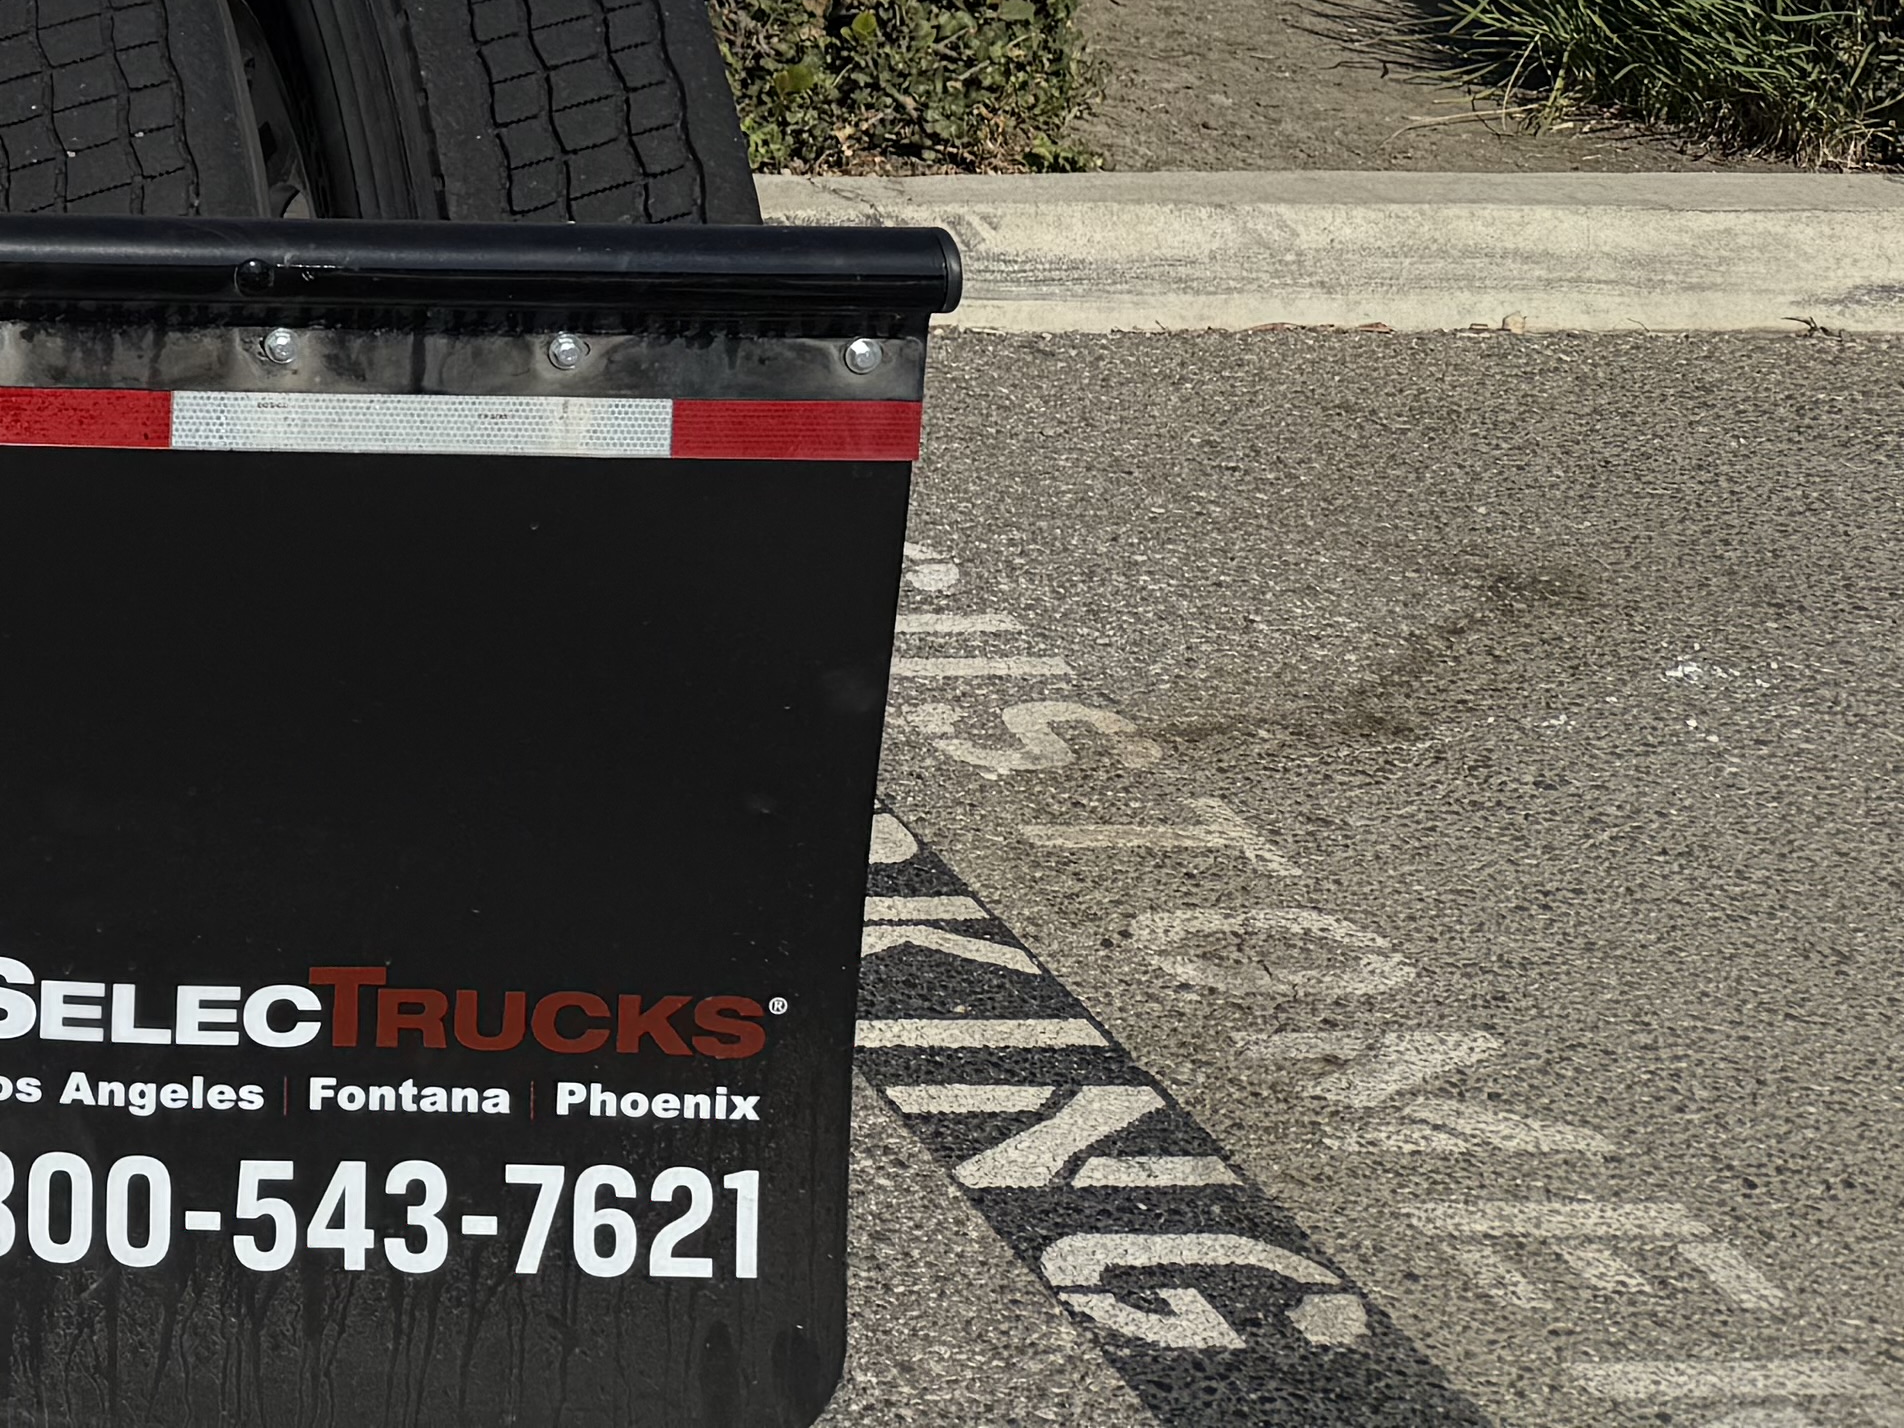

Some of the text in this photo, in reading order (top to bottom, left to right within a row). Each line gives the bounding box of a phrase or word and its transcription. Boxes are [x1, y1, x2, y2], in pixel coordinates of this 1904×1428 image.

[59, 1071, 265, 1117] Angeles
[309, 1076, 511, 1114] Fontana
[556, 1081, 761, 1121] Phoenix
